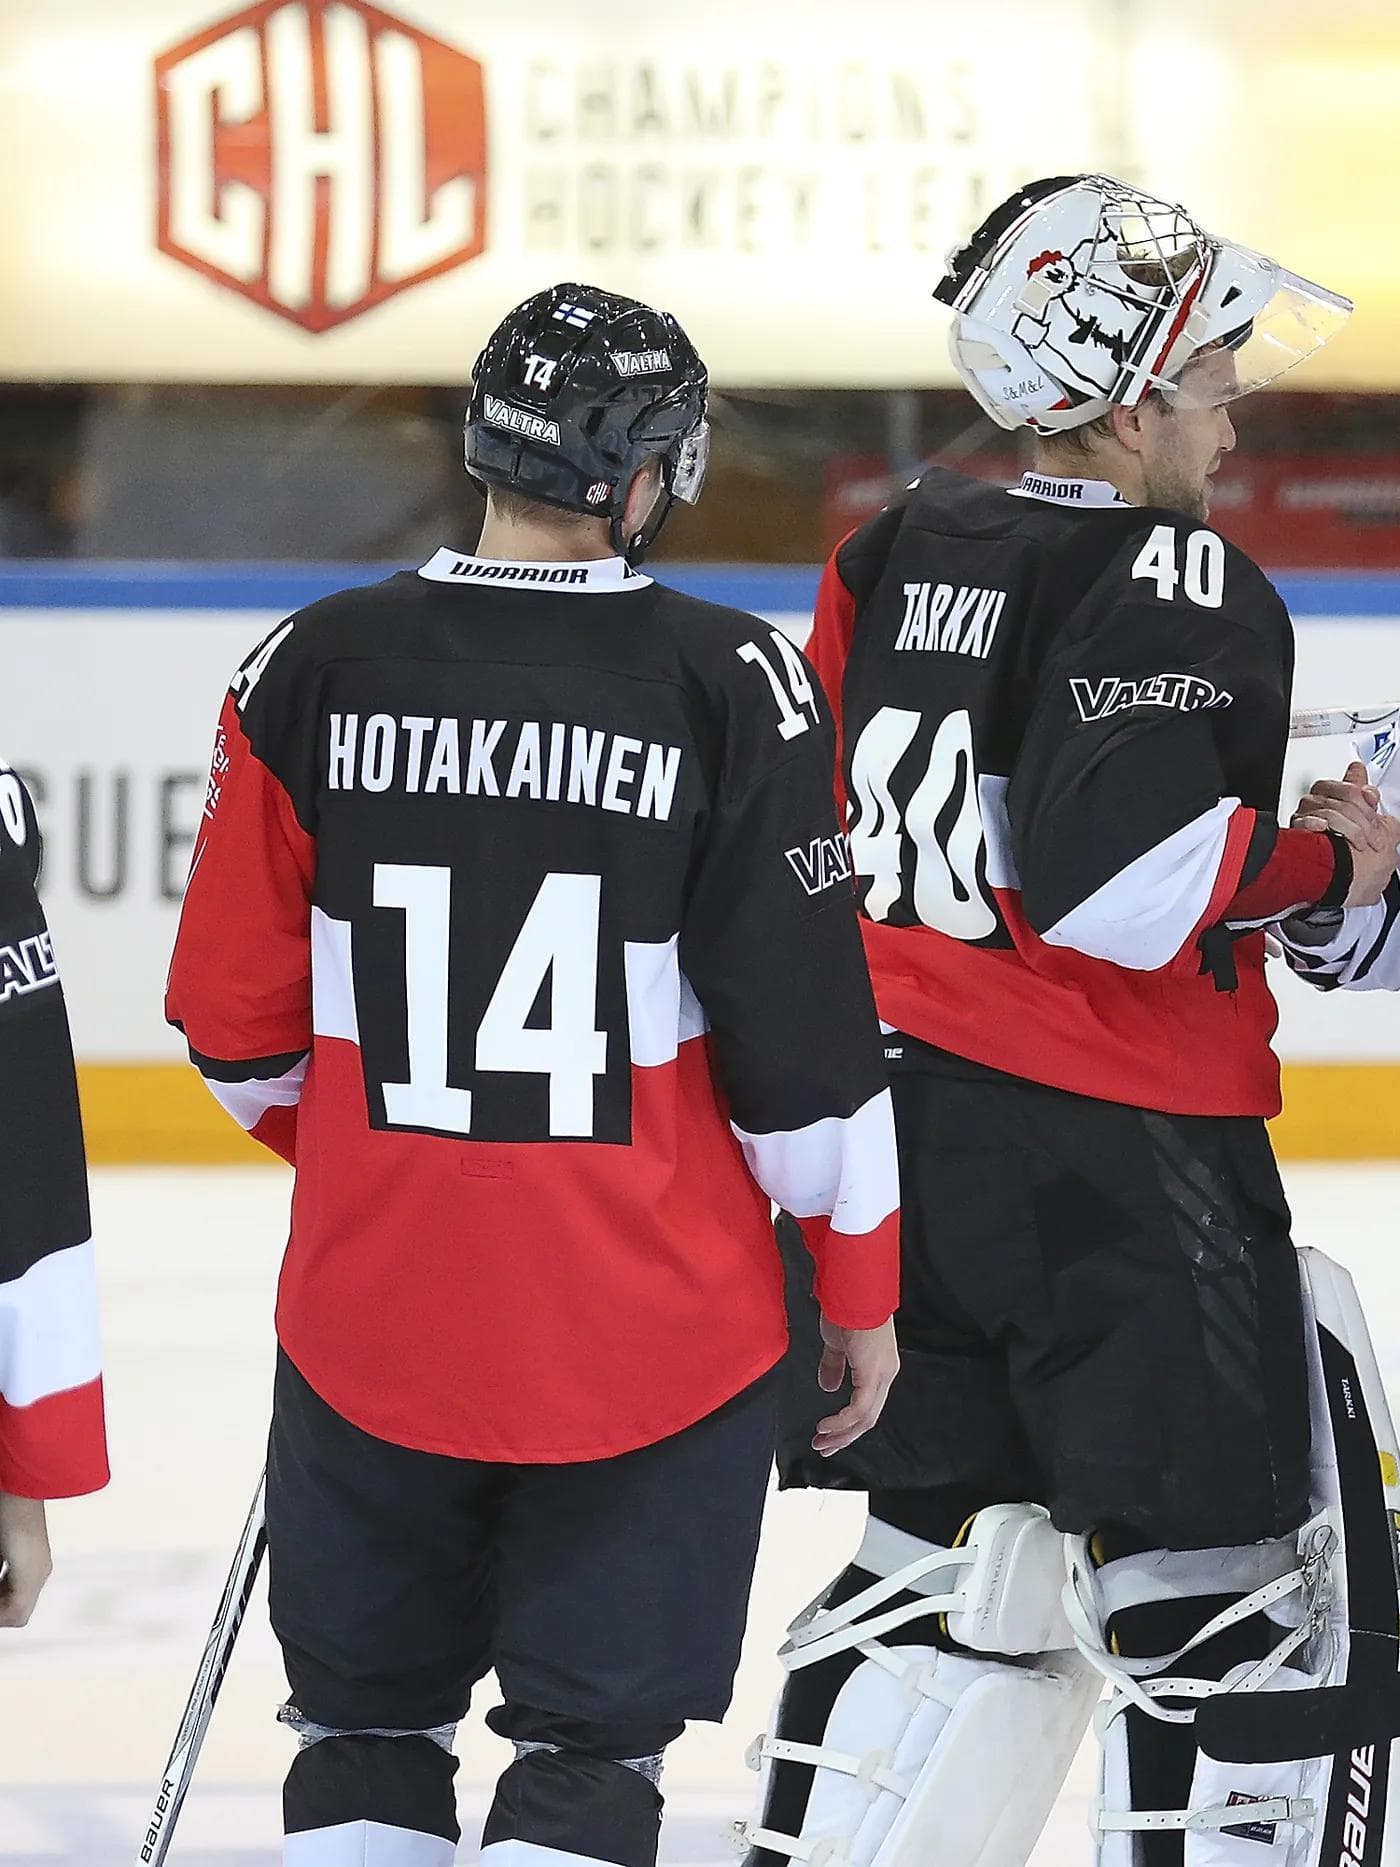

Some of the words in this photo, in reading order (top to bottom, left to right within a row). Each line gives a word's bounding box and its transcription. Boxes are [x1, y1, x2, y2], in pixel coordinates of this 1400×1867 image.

[523, 58, 982, 142] CHAMPIONS
[168, 4, 478, 312] CHL
[523, 161, 820, 255] HOCKEY
[525, 353, 557, 391] 14
[611, 350, 673, 377] VALTRA
[484, 394, 561, 446] VALTRA
[586, 482, 612, 505] CHL
[450, 561, 589, 585] WARRIOR
[1132, 525, 1226, 609] 40
[894, 582, 1007, 660] TARKKI
[735, 630, 821, 741] 14
[328, 713, 682, 822] HOTAKAINEN
[847, 705, 998, 941] 40
[371, 862, 608, 1139] 14
[1340, 1377, 1356, 1420] TARKKI
[139, 1778, 176, 1866] BAUER
